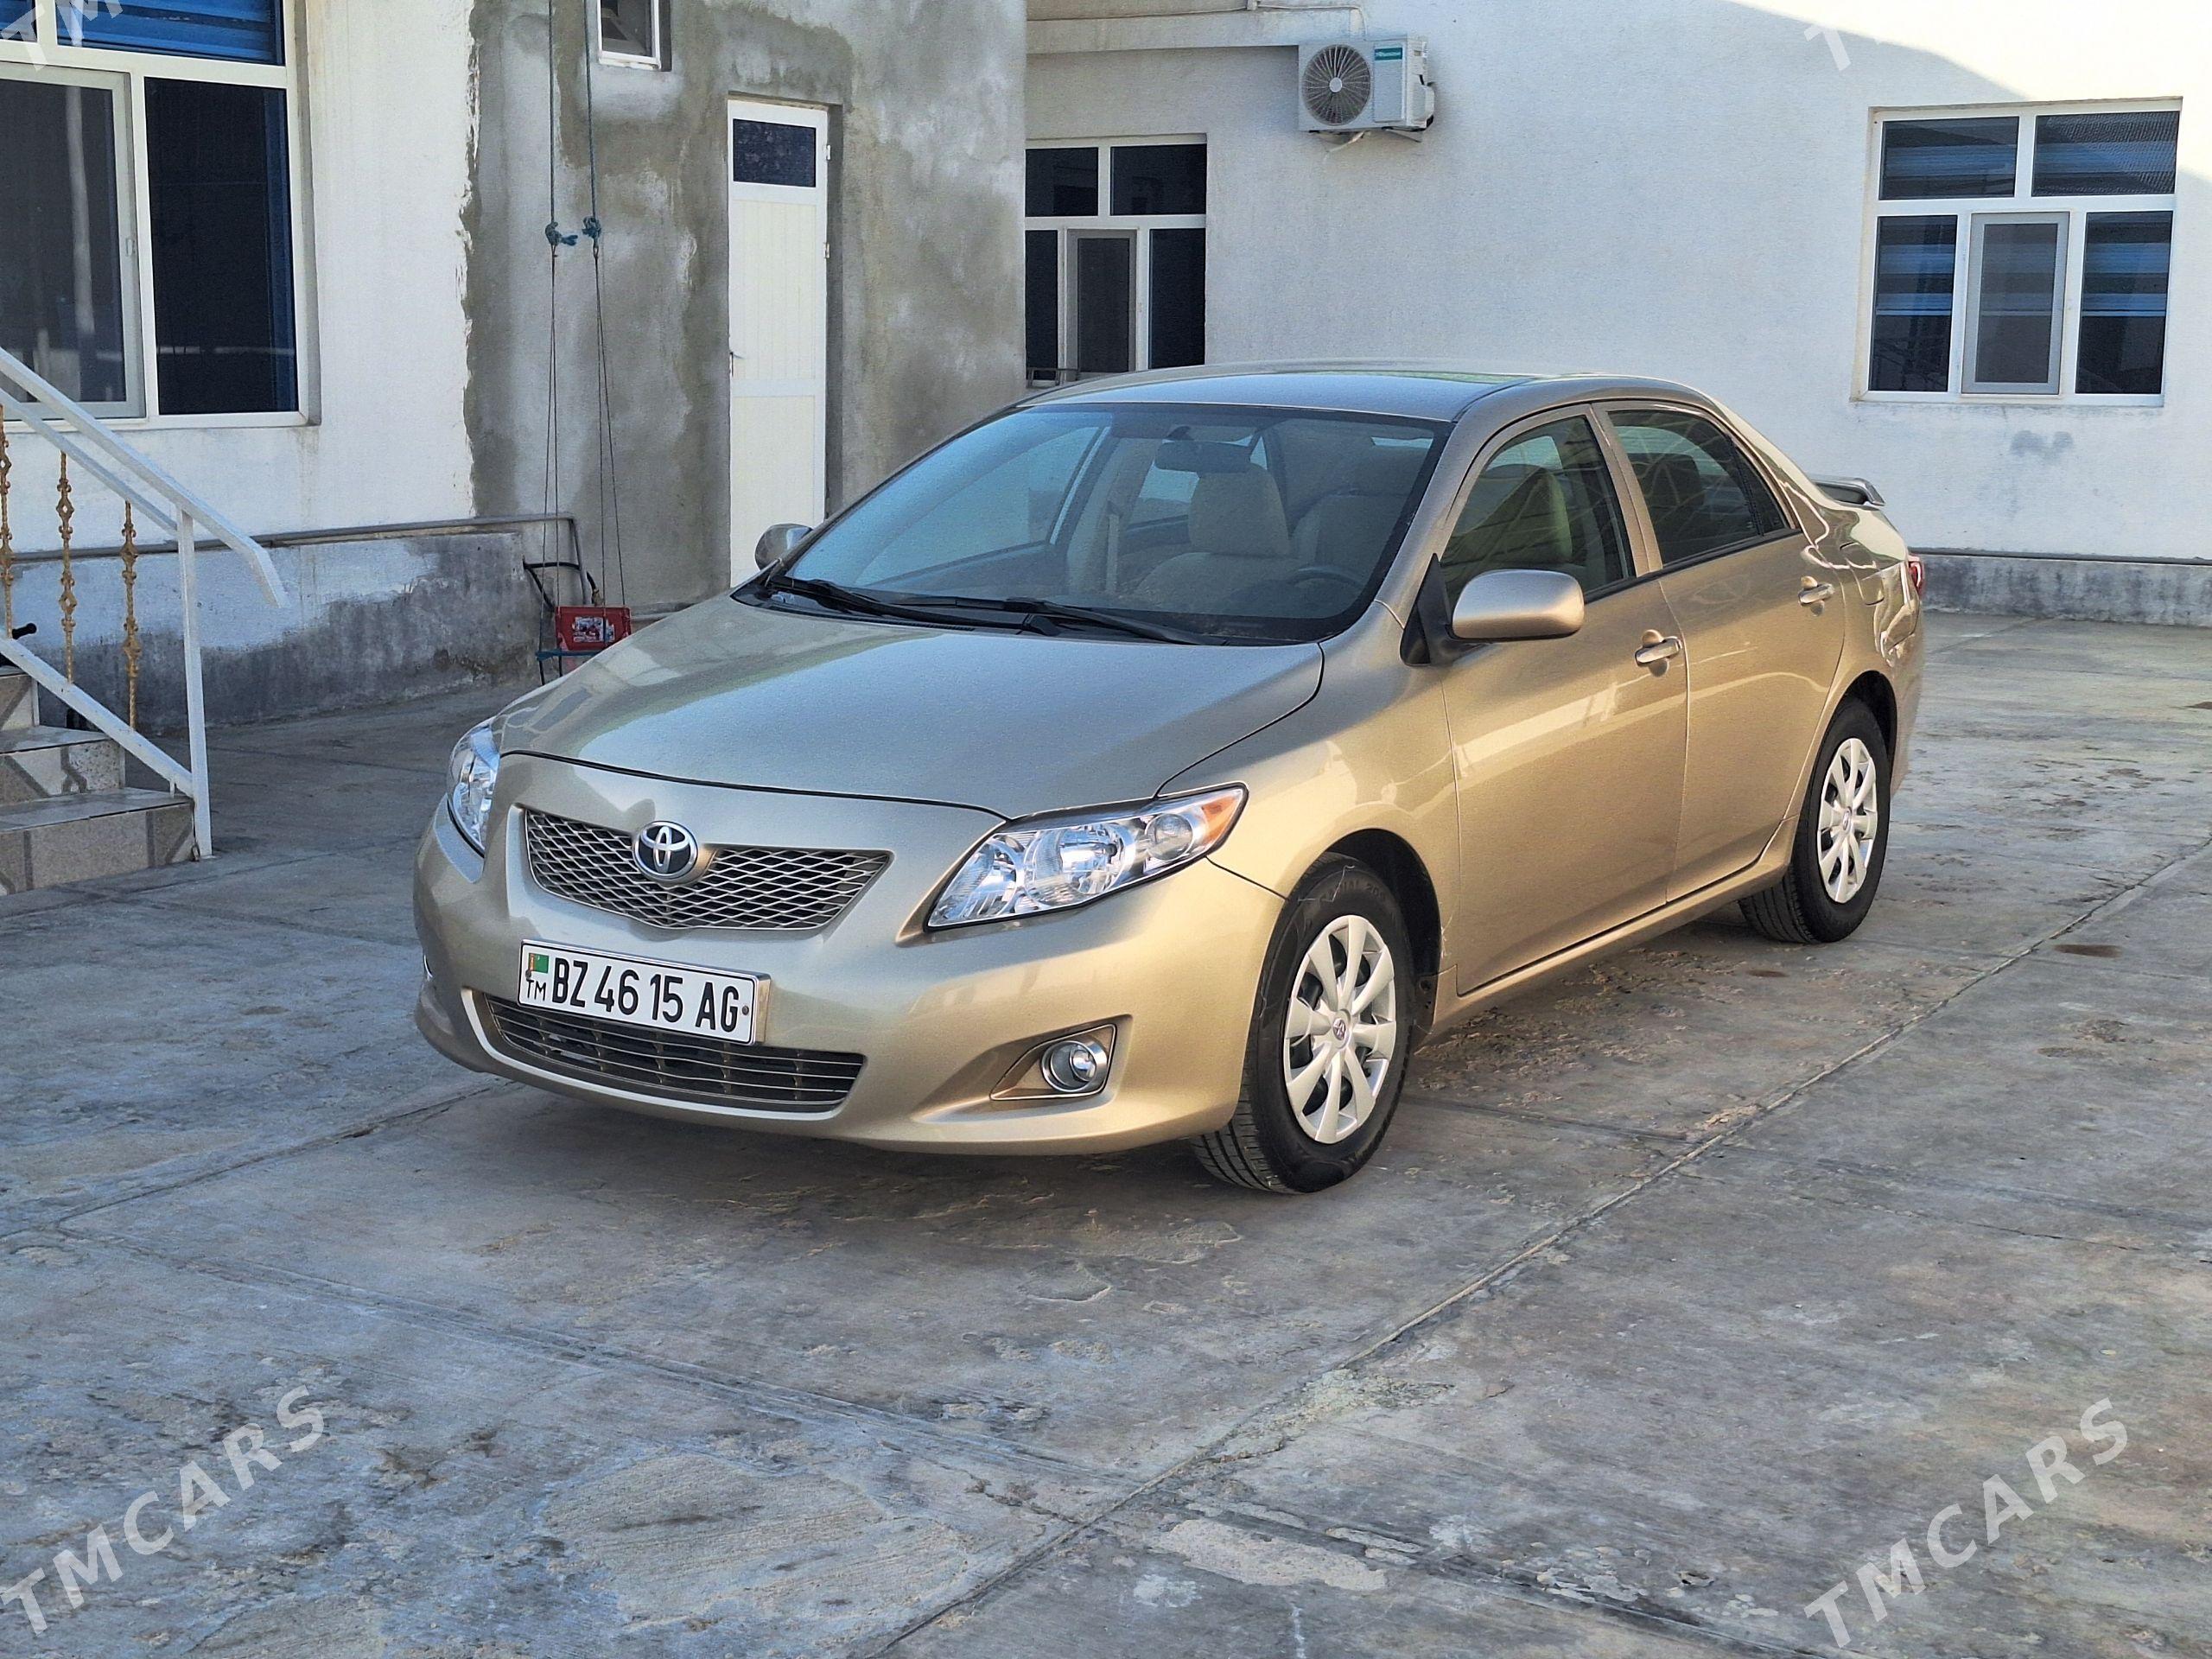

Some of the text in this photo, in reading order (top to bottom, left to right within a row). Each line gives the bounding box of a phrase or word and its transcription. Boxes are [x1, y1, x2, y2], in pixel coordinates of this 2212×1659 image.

[526, 978, 546, 1001] TM
[551, 957, 740, 1033] BZ 46 15 AG
